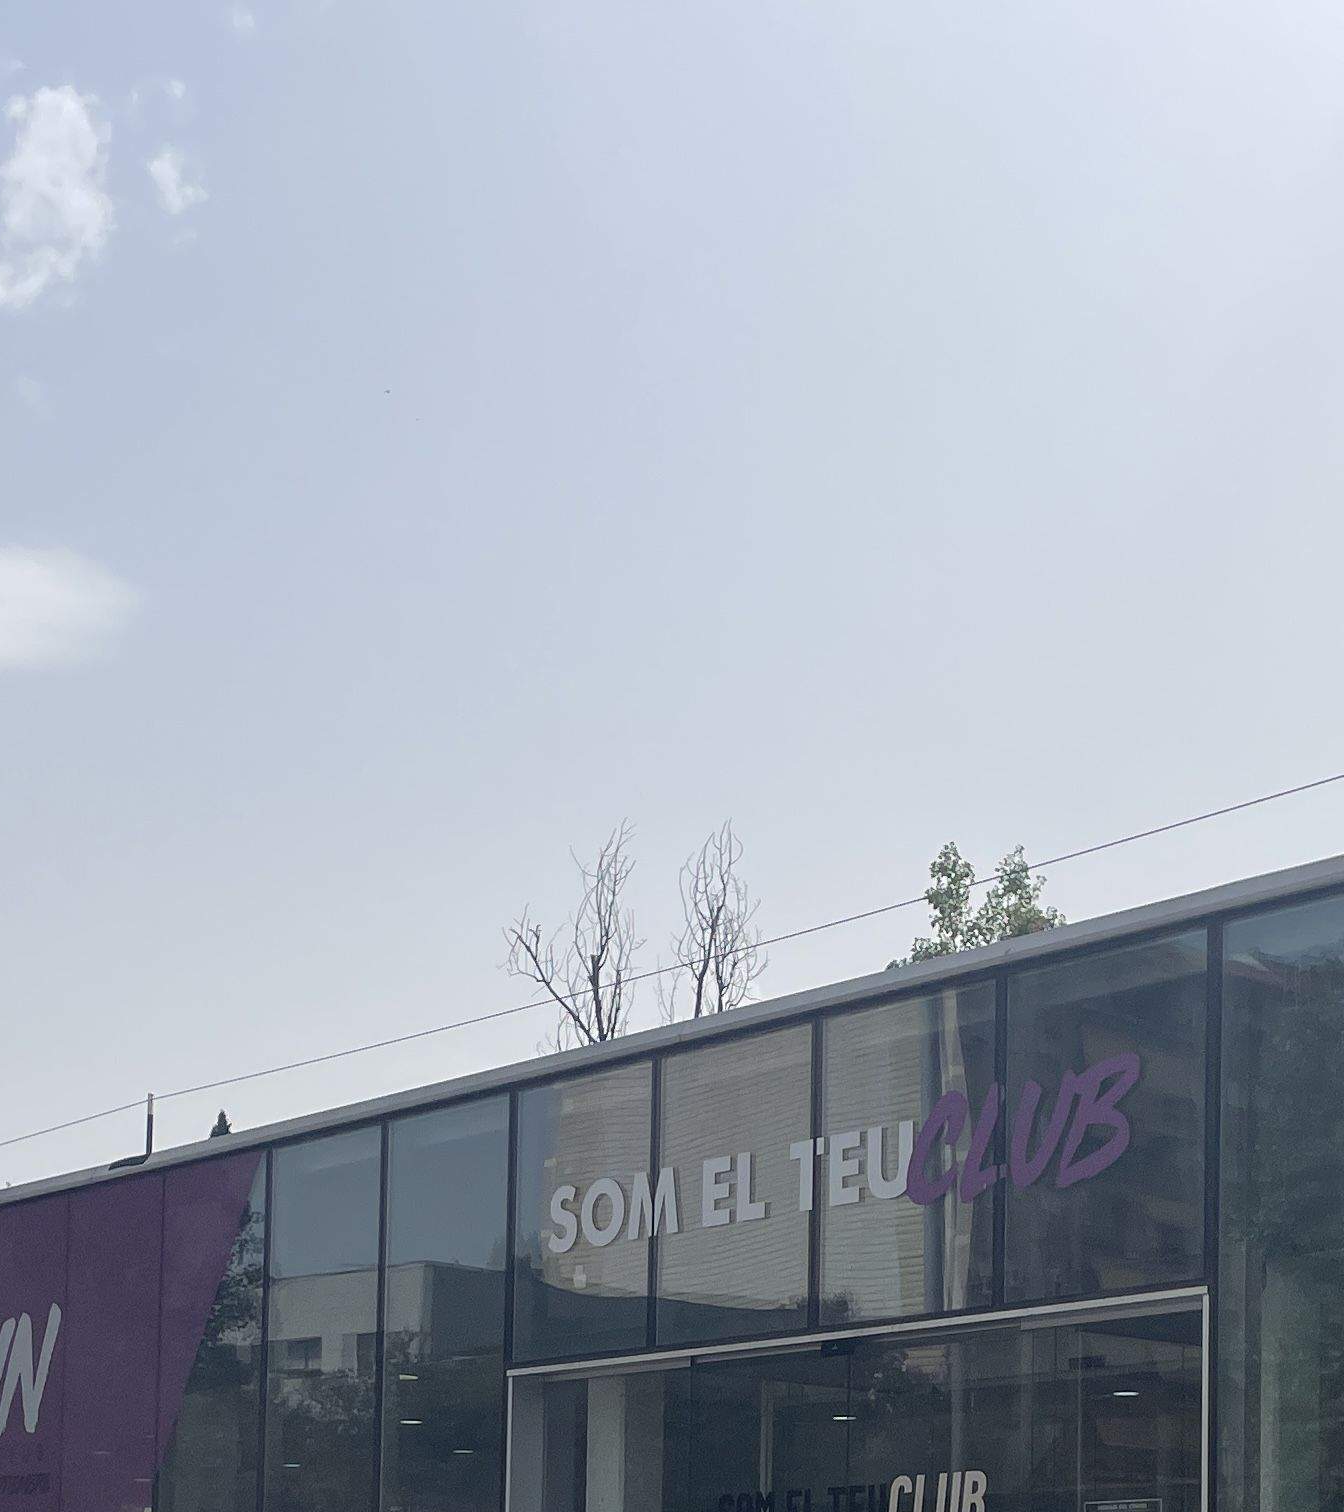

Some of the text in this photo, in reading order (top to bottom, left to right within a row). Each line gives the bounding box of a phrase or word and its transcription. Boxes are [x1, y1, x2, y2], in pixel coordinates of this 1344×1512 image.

[547, 1052, 1142, 1254] SOM EL TEU CLUB
